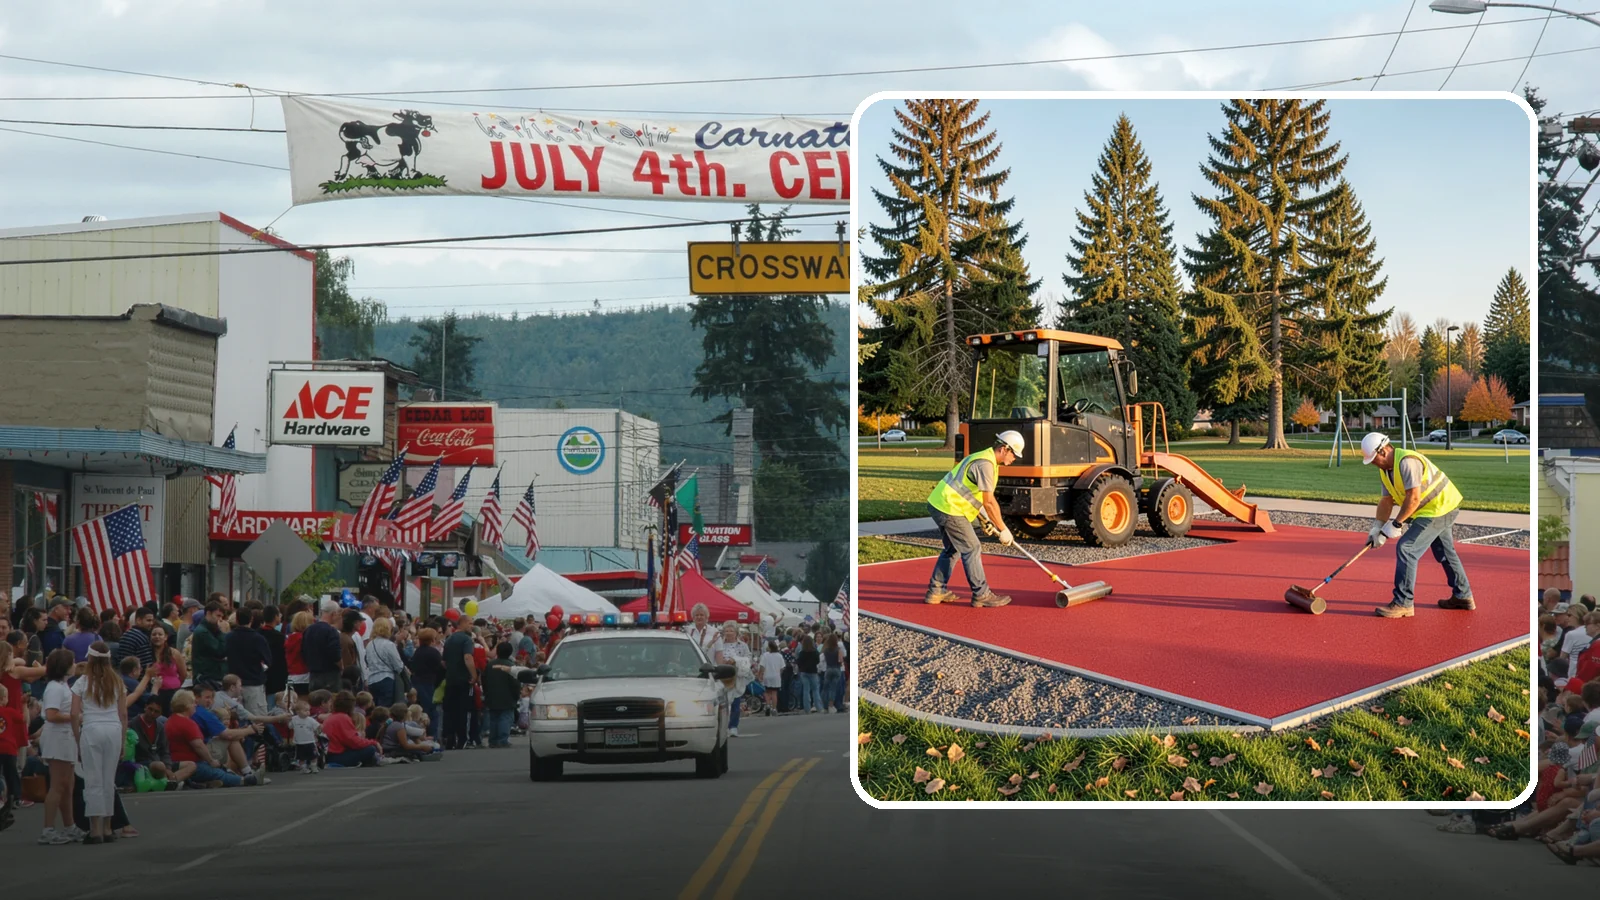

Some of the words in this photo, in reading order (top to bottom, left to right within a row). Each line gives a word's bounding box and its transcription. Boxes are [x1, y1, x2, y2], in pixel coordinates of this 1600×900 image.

[695, 121, 850, 150] Carnat
[481, 141, 605, 192] JULY
[632, 150, 747, 198] 4th.
[697, 254, 850, 280] CROSSWA
[283, 380, 373, 420] ACE
[406, 409, 452, 422] CEDAR
[461, 409, 485, 422] LOG
[283, 421, 371, 436] Hardware
[416, 428, 477, 447] Coca-Cola
[353, 467, 386, 480] Simpl
[83, 484, 94, 494] St.
[95, 485, 125, 495] Vincent
[126, 486, 136, 495] de
[137, 486, 155, 495] Paul
[212, 516, 331, 535] HARDARE
[688, 526, 741, 535] CRNATION
[699, 535, 730, 543] GLASS
